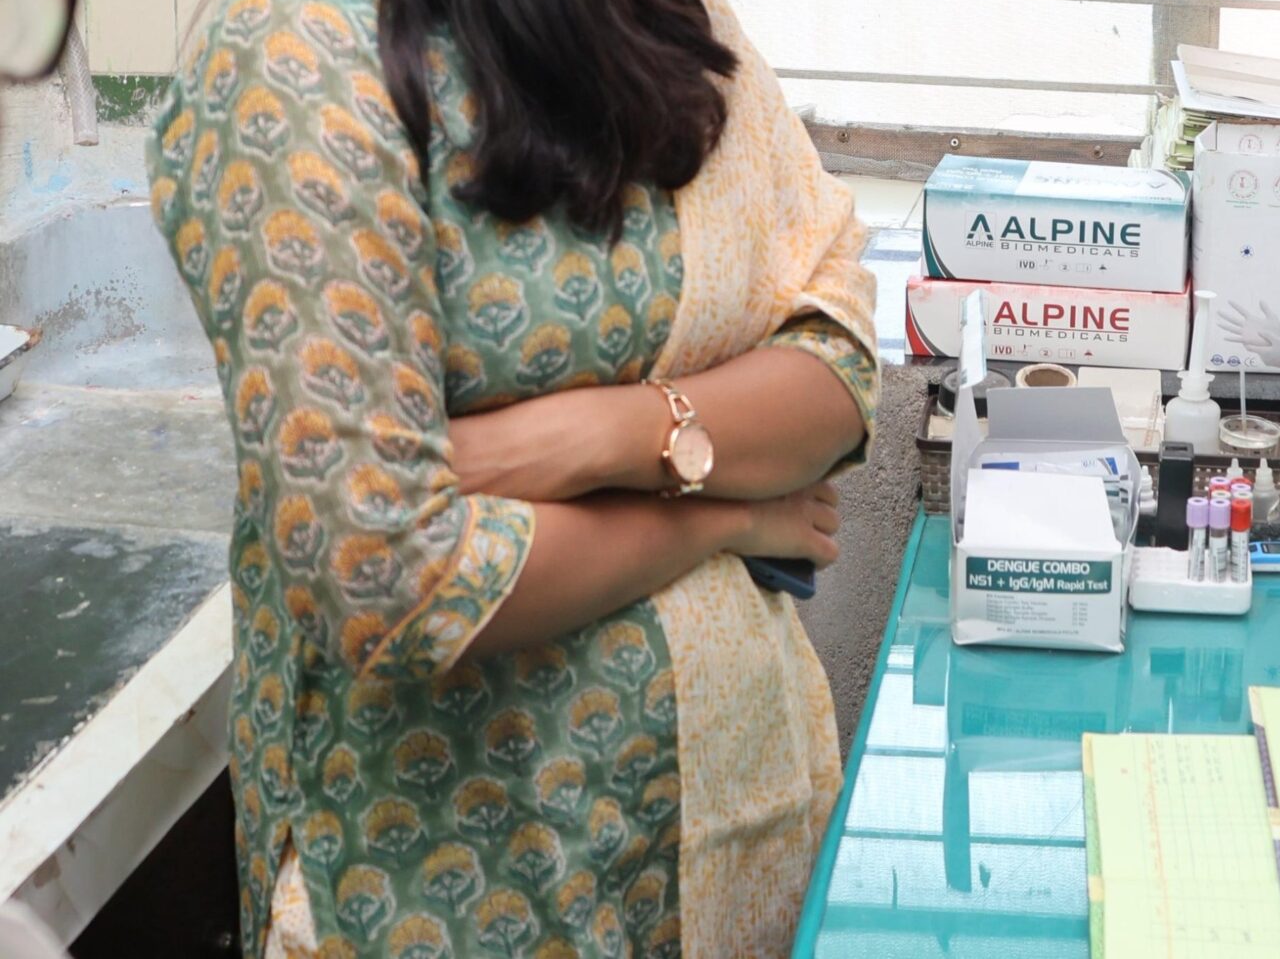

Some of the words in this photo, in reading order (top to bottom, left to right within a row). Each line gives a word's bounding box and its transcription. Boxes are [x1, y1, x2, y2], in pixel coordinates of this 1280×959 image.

[1000, 216, 1141, 246] ALPINE
[966, 240, 994, 248] ALPINE
[1000, 242, 1139, 258] BIOMEDICALS
[1019, 260, 1036, 269] IVD
[993, 301, 1130, 331] ALPINE
[993, 327, 1128, 343] BIOMEDICALS
[994, 345, 1013, 355] IVD
[987, 559, 1040, 572] DENGUE
[1042, 561, 1091, 575] COMBO
[968, 574, 993, 587] NS1
[996, 578, 1005, 587] +
[1009, 576, 1054, 591] IgG/IgM
[1056, 579, 1085, 591] Rapid
[1087, 580, 1108, 590] Test
